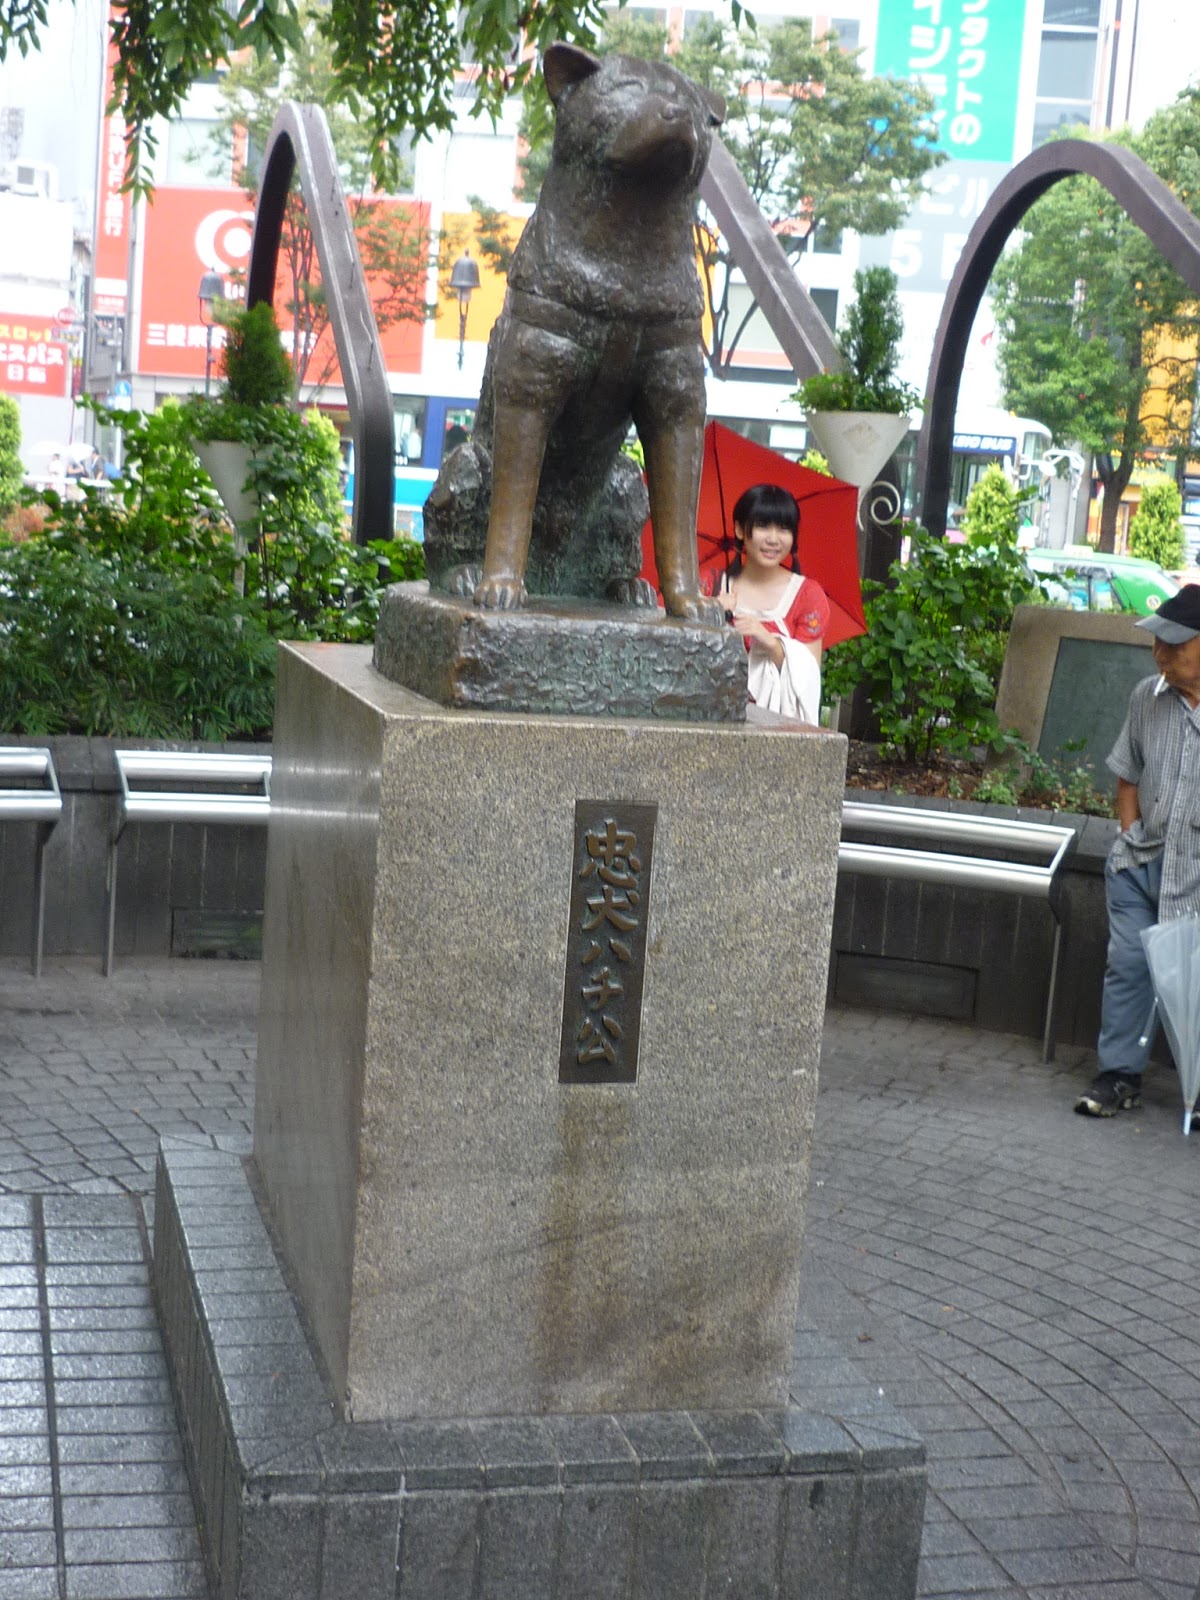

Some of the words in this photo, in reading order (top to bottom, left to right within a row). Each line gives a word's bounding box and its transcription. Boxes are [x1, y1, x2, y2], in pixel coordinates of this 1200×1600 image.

[577, 817, 642, 1066] 忠犬ハチ公
